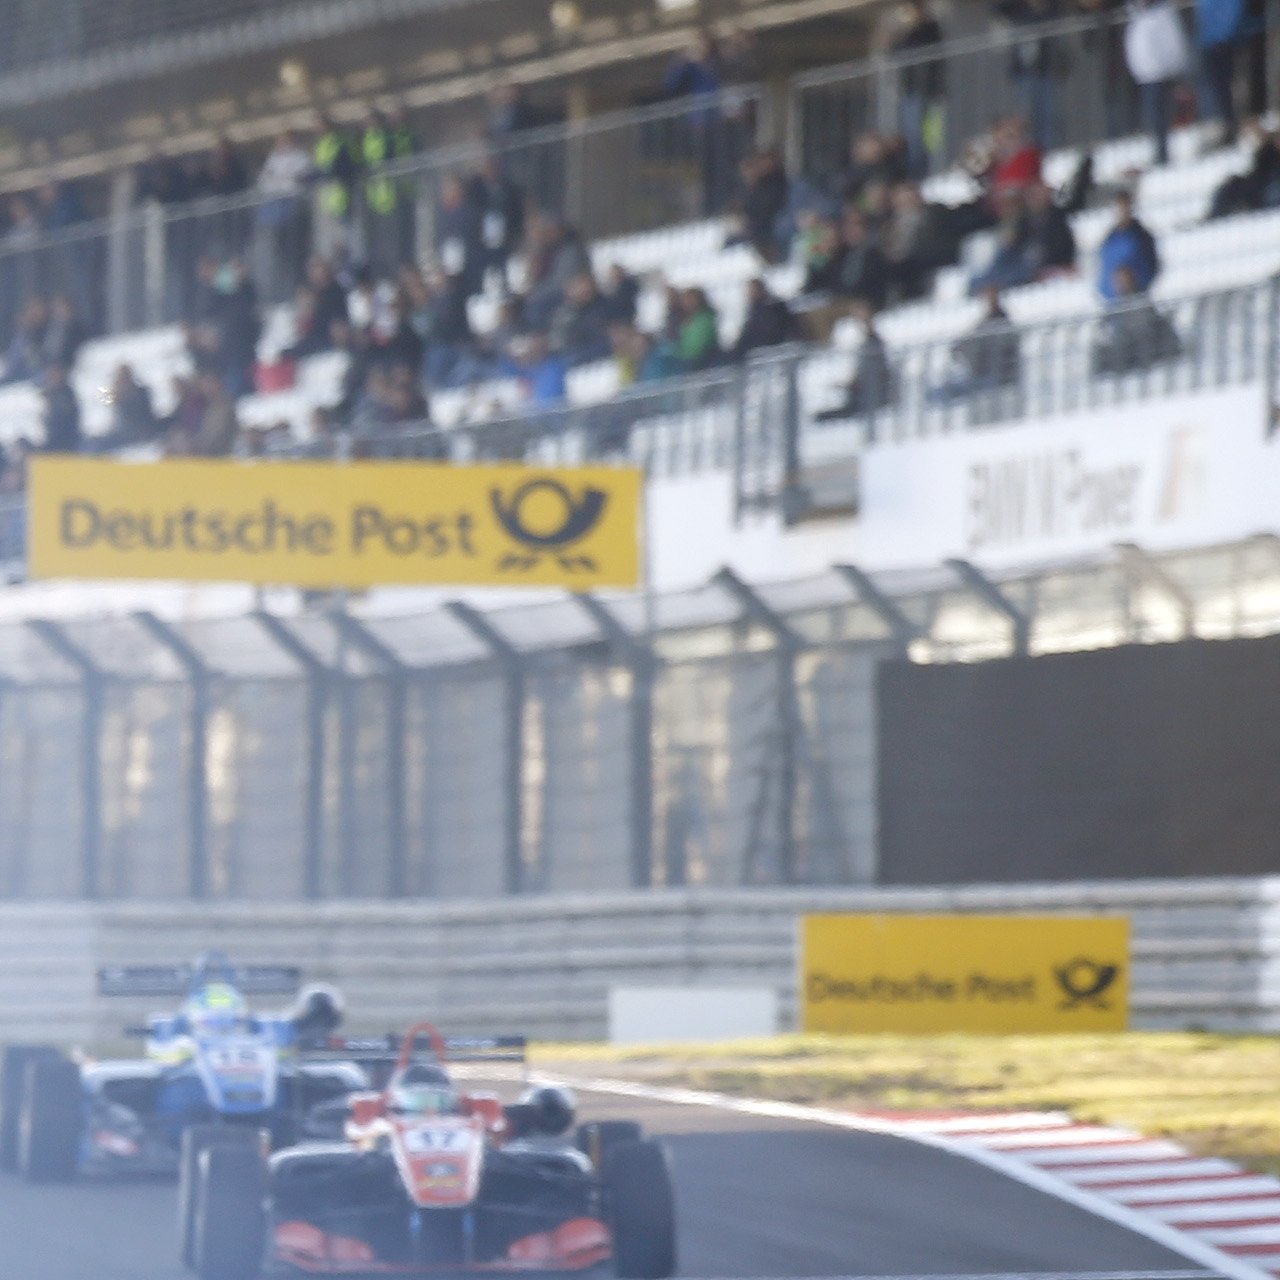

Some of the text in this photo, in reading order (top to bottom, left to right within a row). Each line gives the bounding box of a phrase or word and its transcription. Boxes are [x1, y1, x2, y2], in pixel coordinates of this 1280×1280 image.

[59, 497, 477, 556] Deutsche Post
[806, 971, 1036, 1004] Deutsche Post
